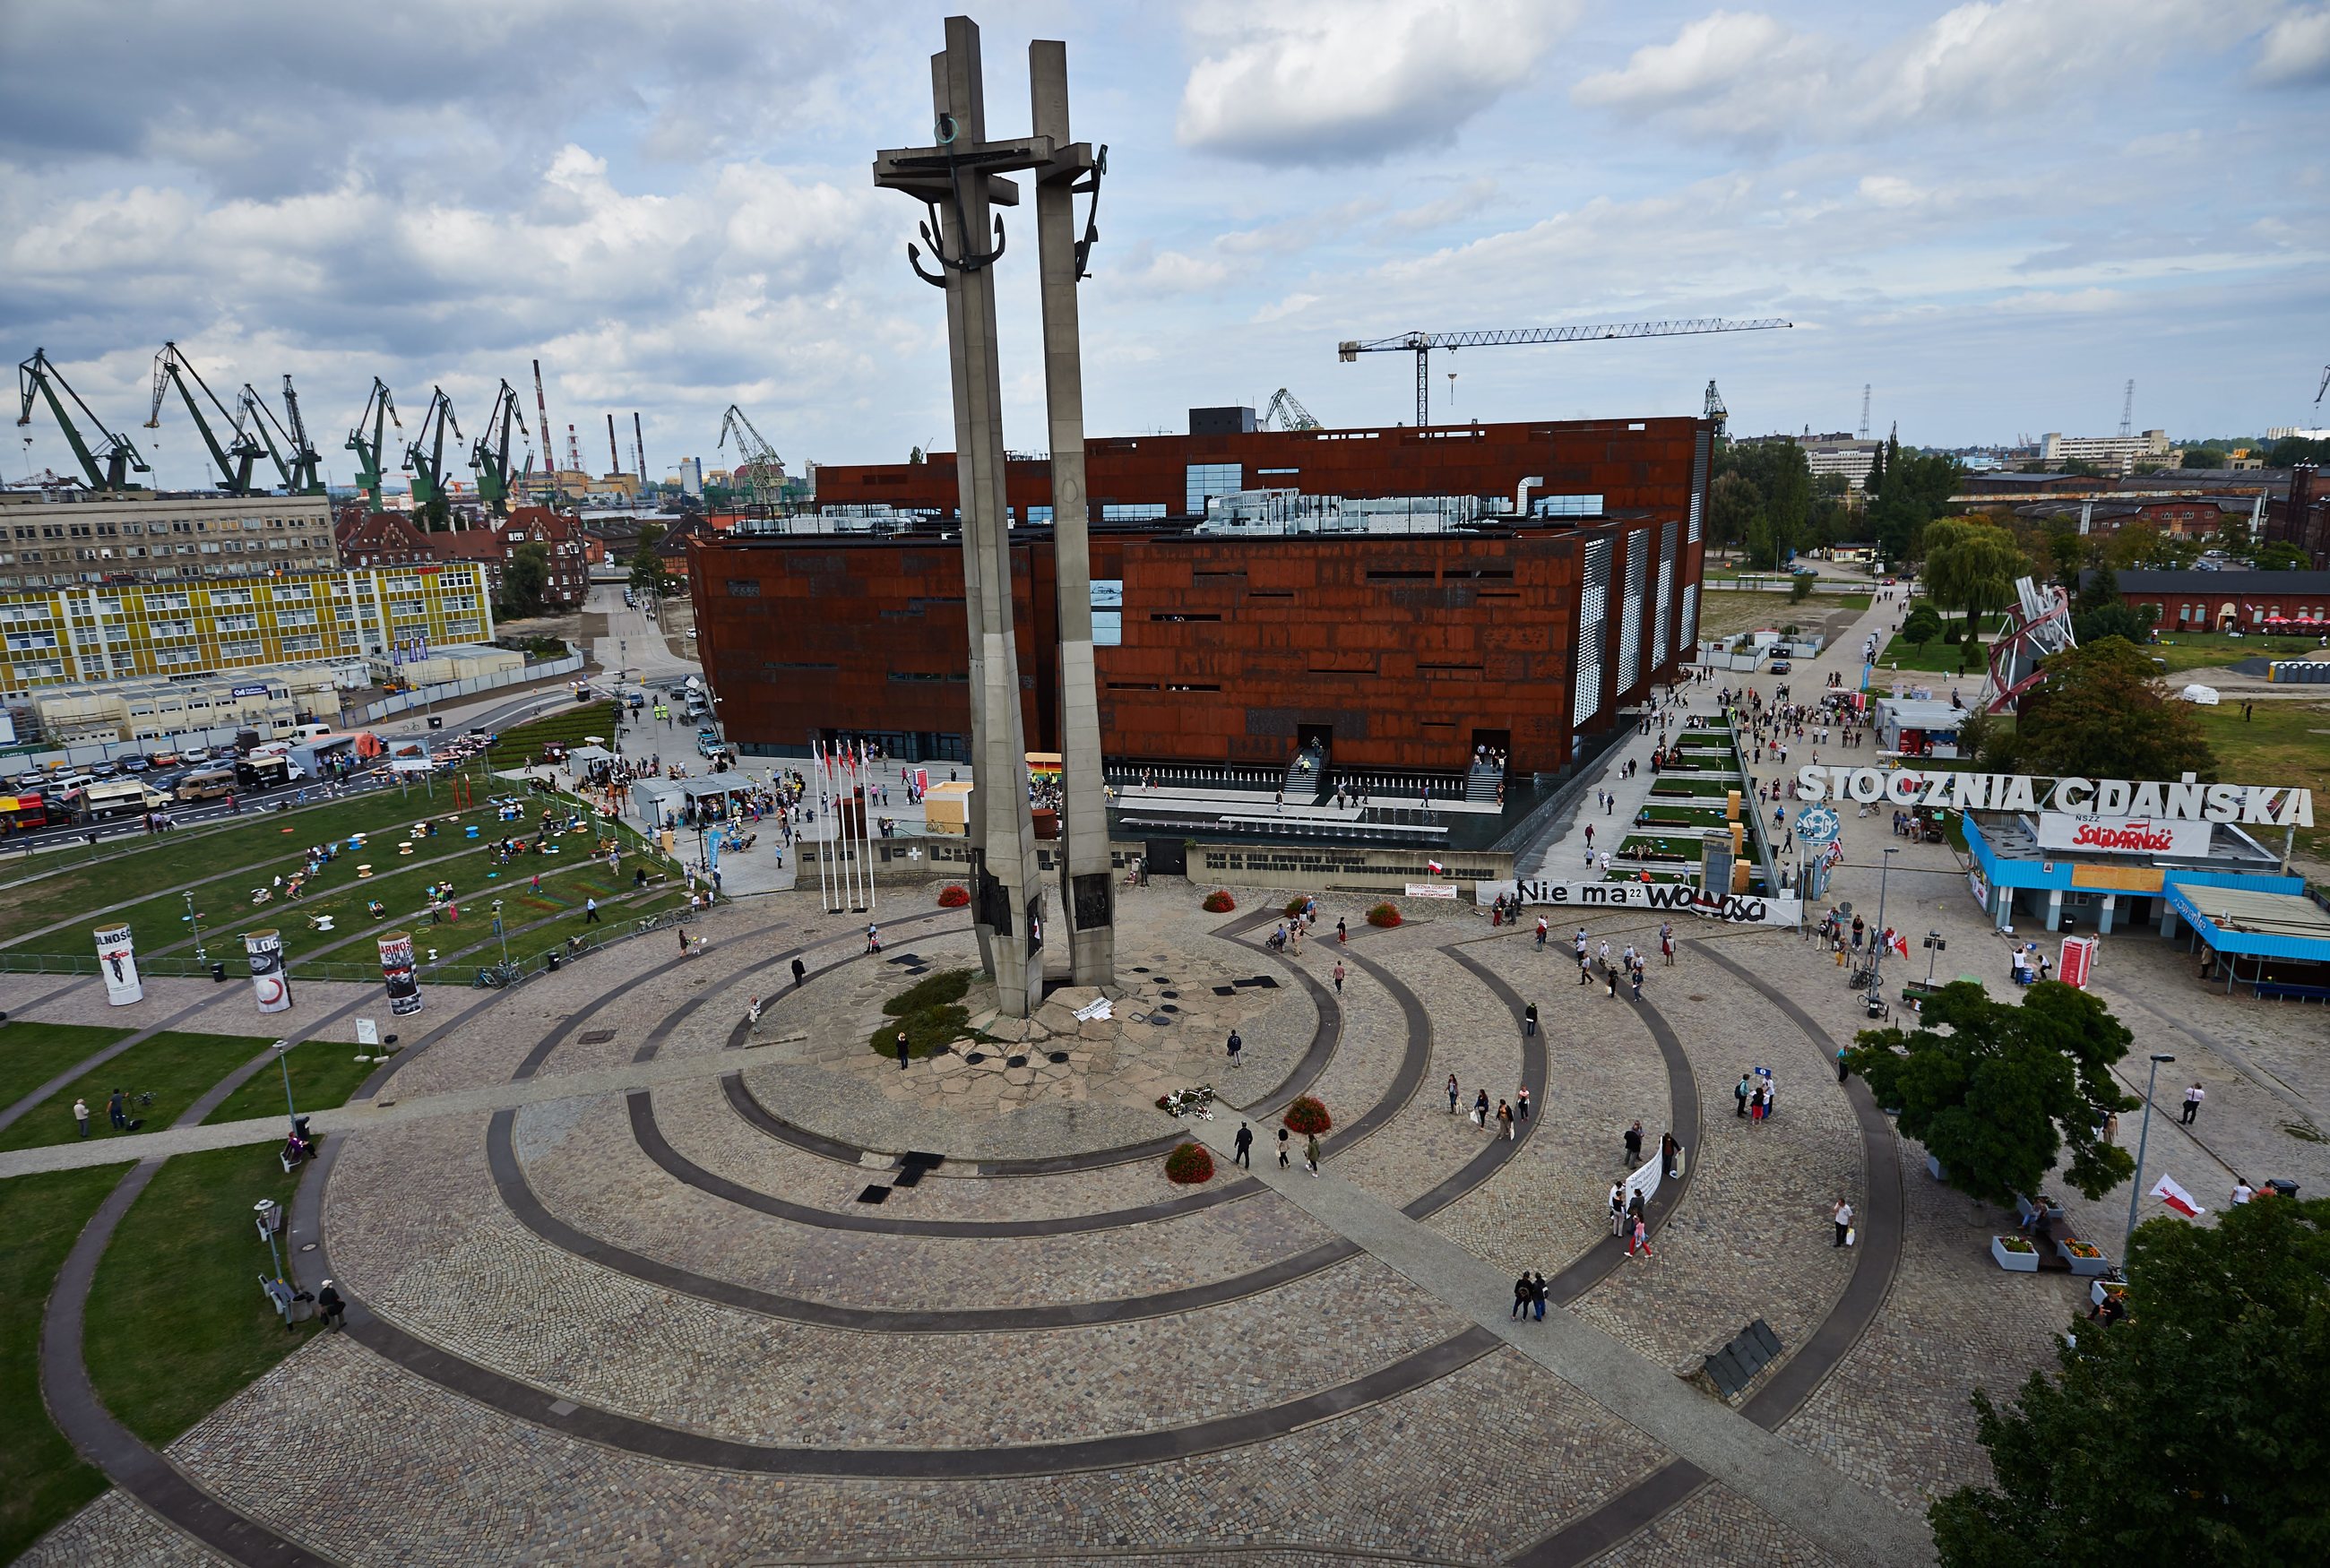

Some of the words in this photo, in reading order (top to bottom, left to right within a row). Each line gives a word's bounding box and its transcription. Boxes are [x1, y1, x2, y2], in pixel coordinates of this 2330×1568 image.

[1797, 764, 2036, 812] STOCZNIA
[2054, 771, 2315, 828] GDAŃSKA
[2075, 814, 2101, 823] NSZZ
[1517, 881, 1568, 902] Nie
[1583, 886, 1627, 903] ma
[1629, 889, 1642, 898] 22
